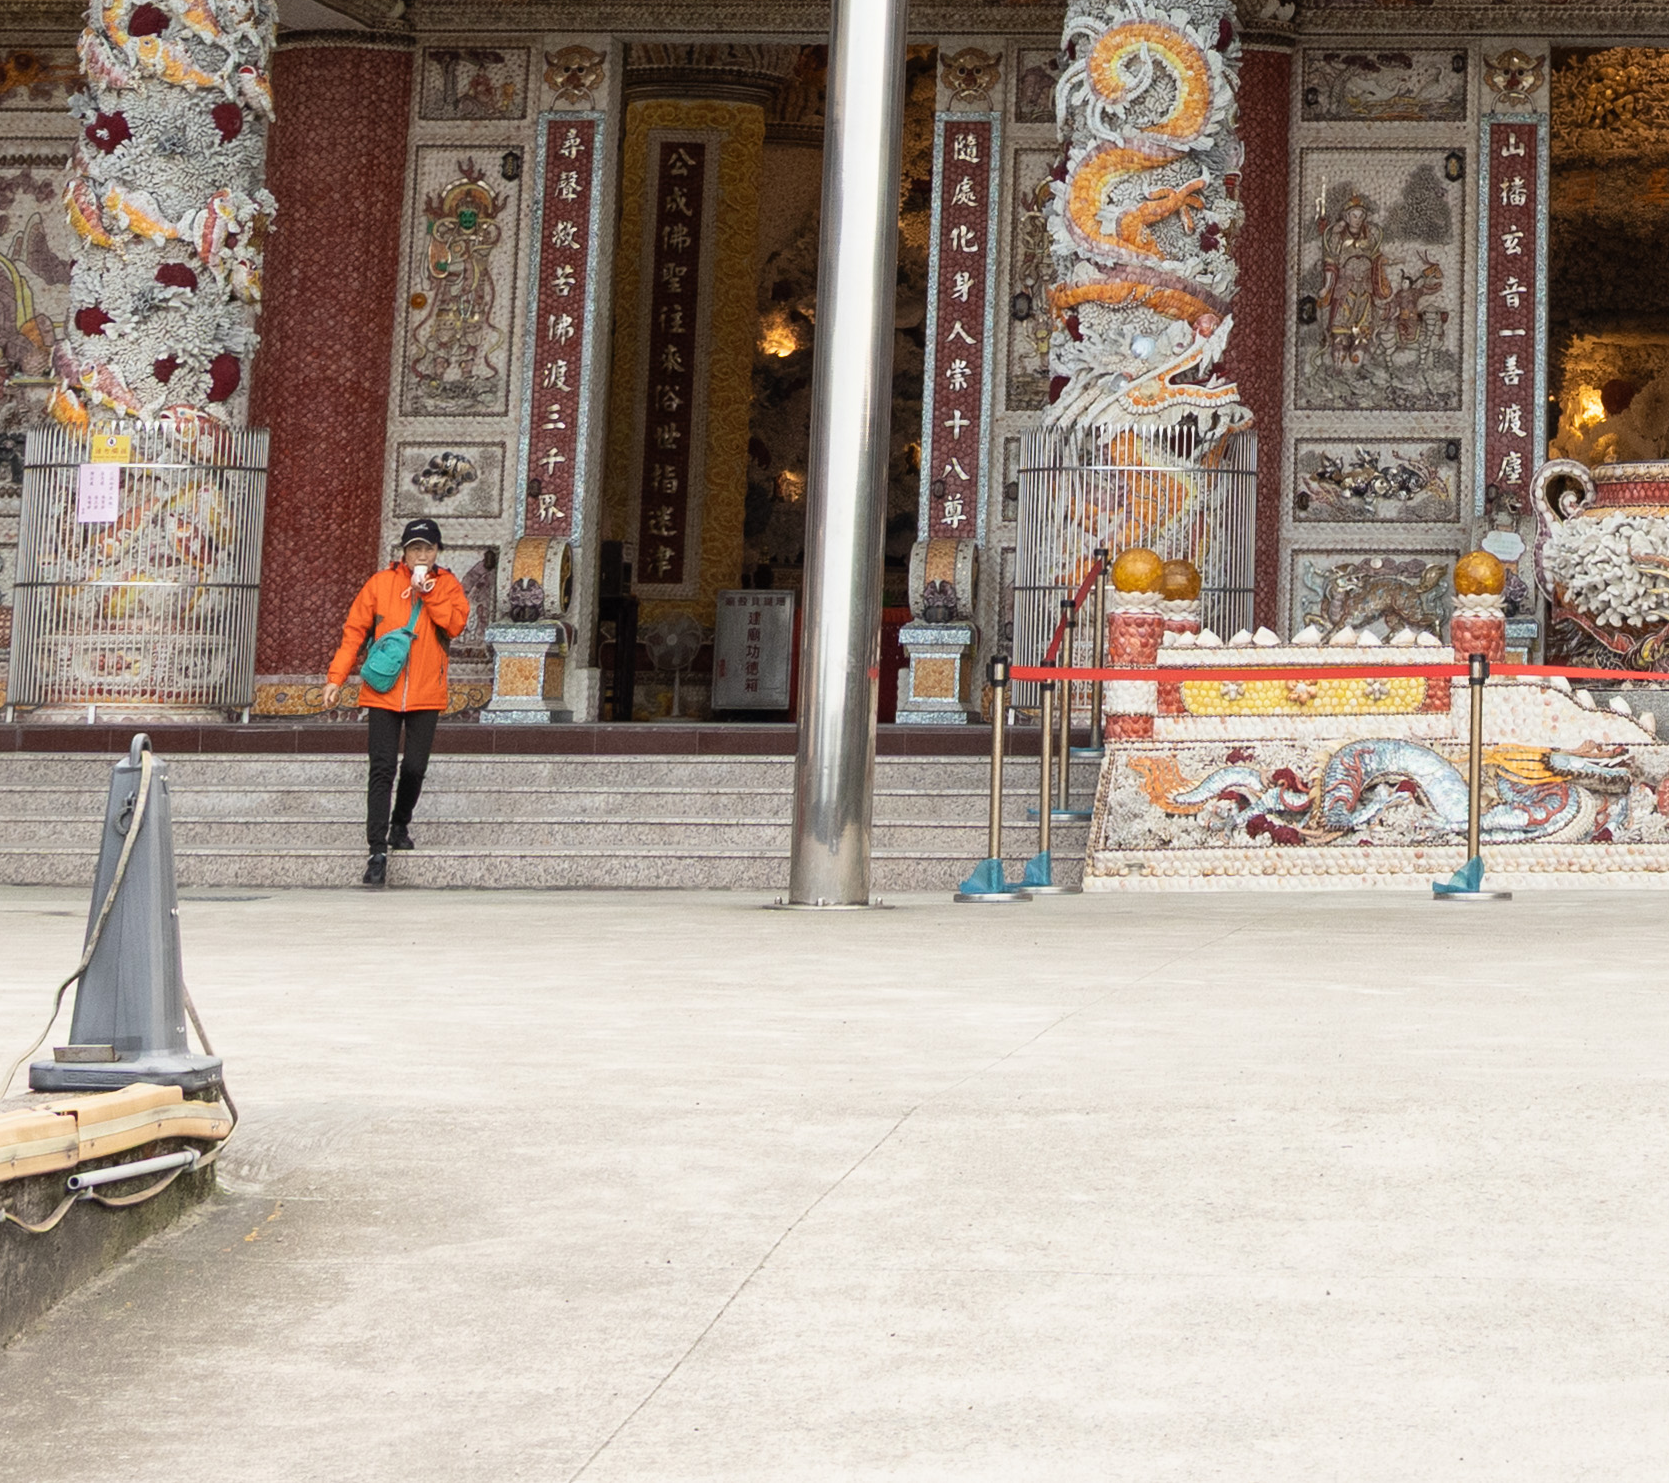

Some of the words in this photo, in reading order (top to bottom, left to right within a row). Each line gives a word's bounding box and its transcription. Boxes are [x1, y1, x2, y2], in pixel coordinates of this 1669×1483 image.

[941, 133, 981, 530] 隨處化身人崇十八尊
